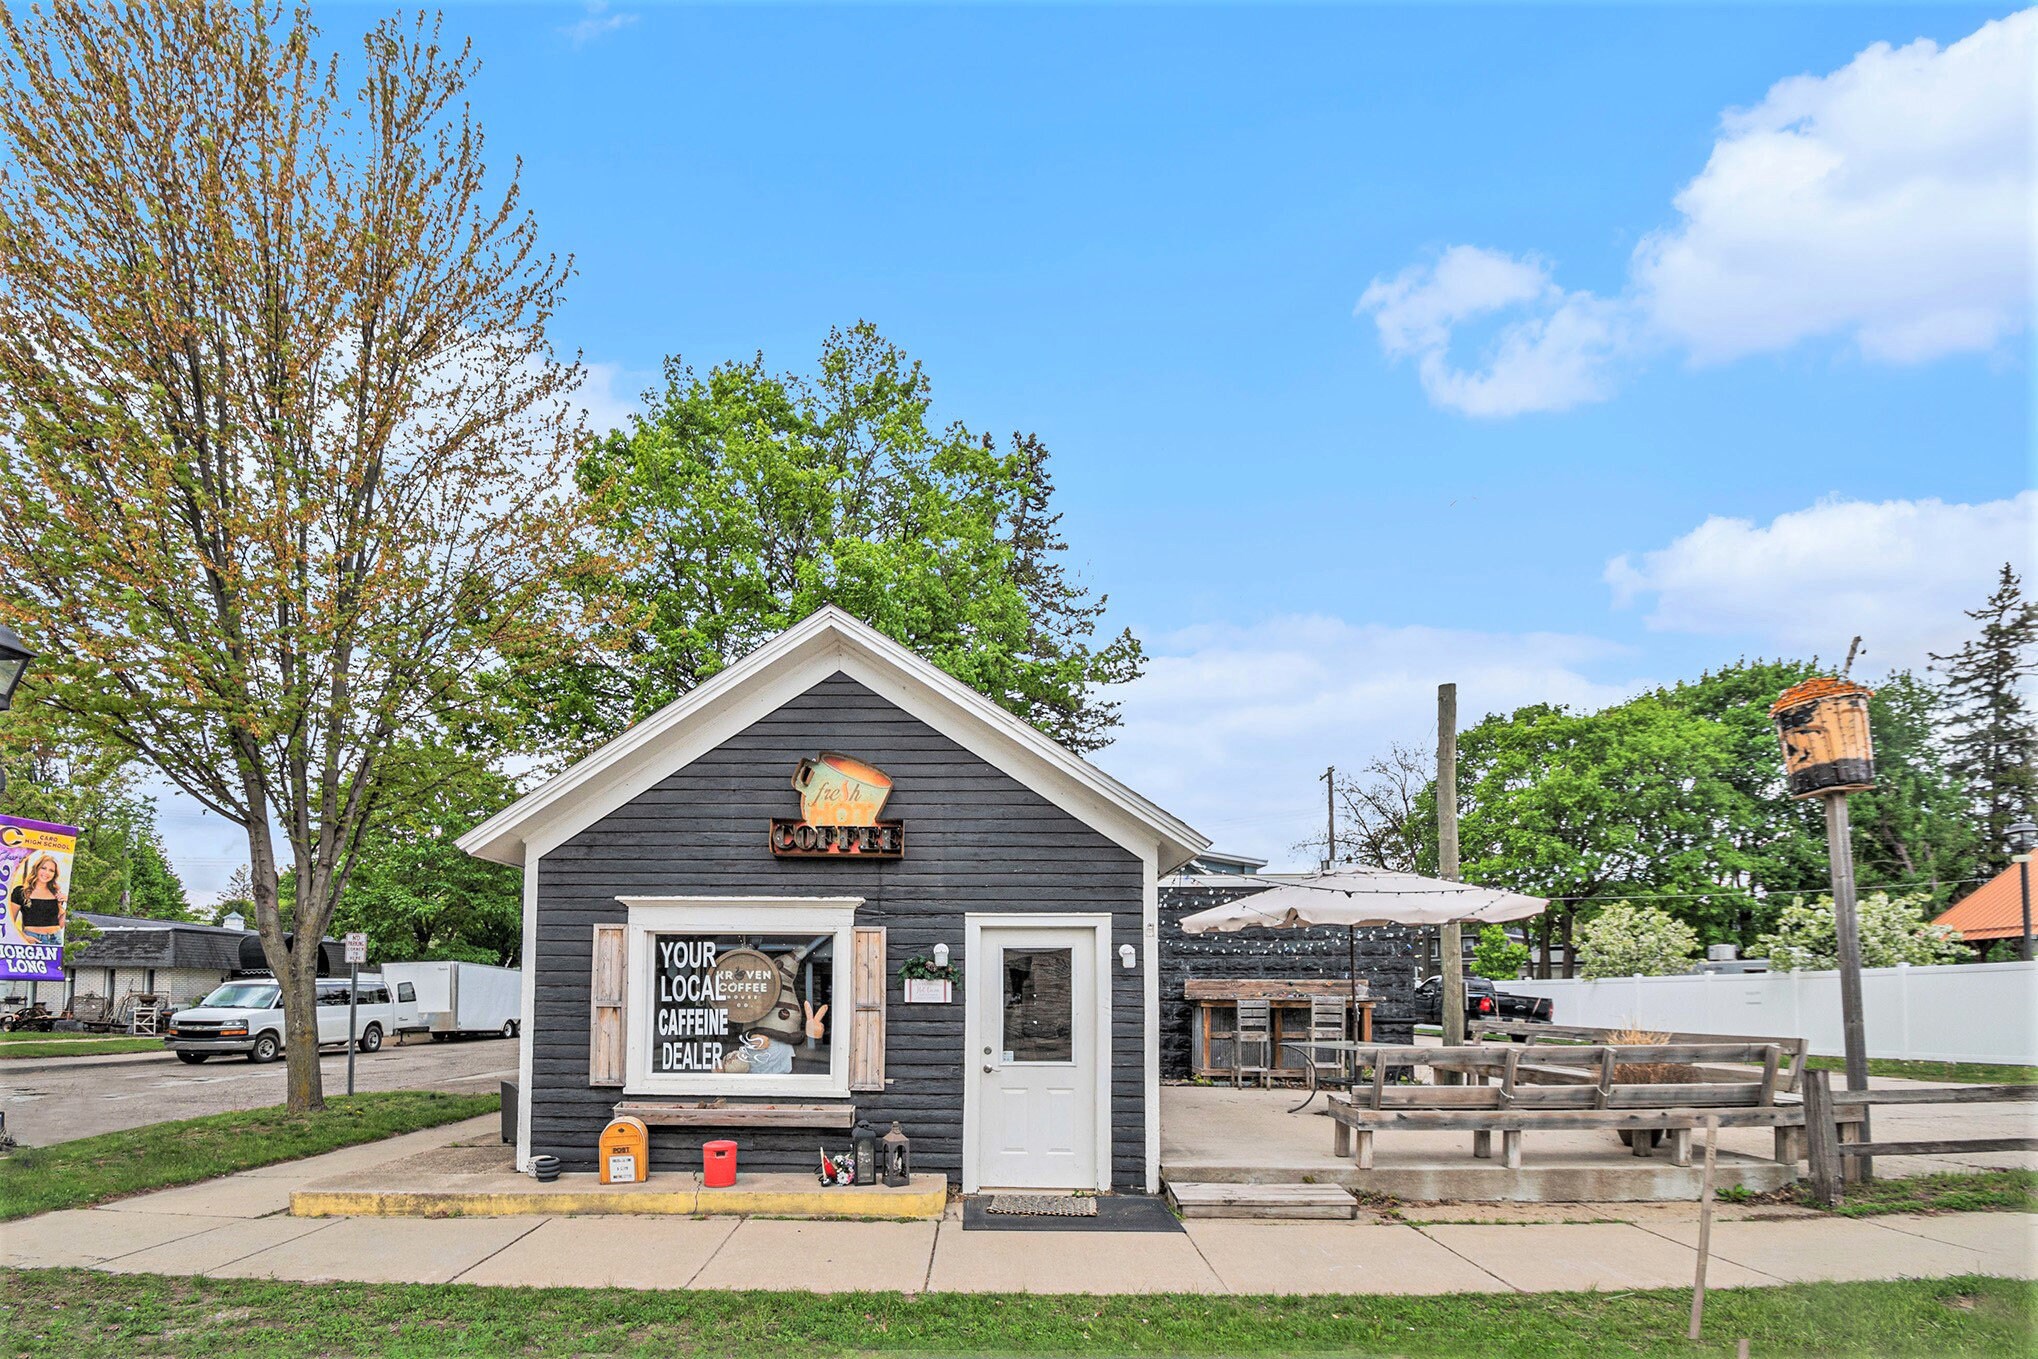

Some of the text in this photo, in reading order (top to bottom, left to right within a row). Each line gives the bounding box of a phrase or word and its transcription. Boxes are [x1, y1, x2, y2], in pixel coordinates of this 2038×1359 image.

[809, 801, 876, 827] HOT
[39, 834, 59, 842] CARO
[43, 841, 70, 850] SCHOOL
[772, 824, 902, 851] COFFEE
[6, 959, 47, 974] LONG
[660, 941, 717, 969] YOUR
[661, 974, 727, 1002] LOCAL
[718, 982, 768, 993] COFFEE
[658, 1008, 729, 1036] CAFFEINE
[662, 1041, 724, 1070] DEALER
[612, 1146, 630, 1154] POST
